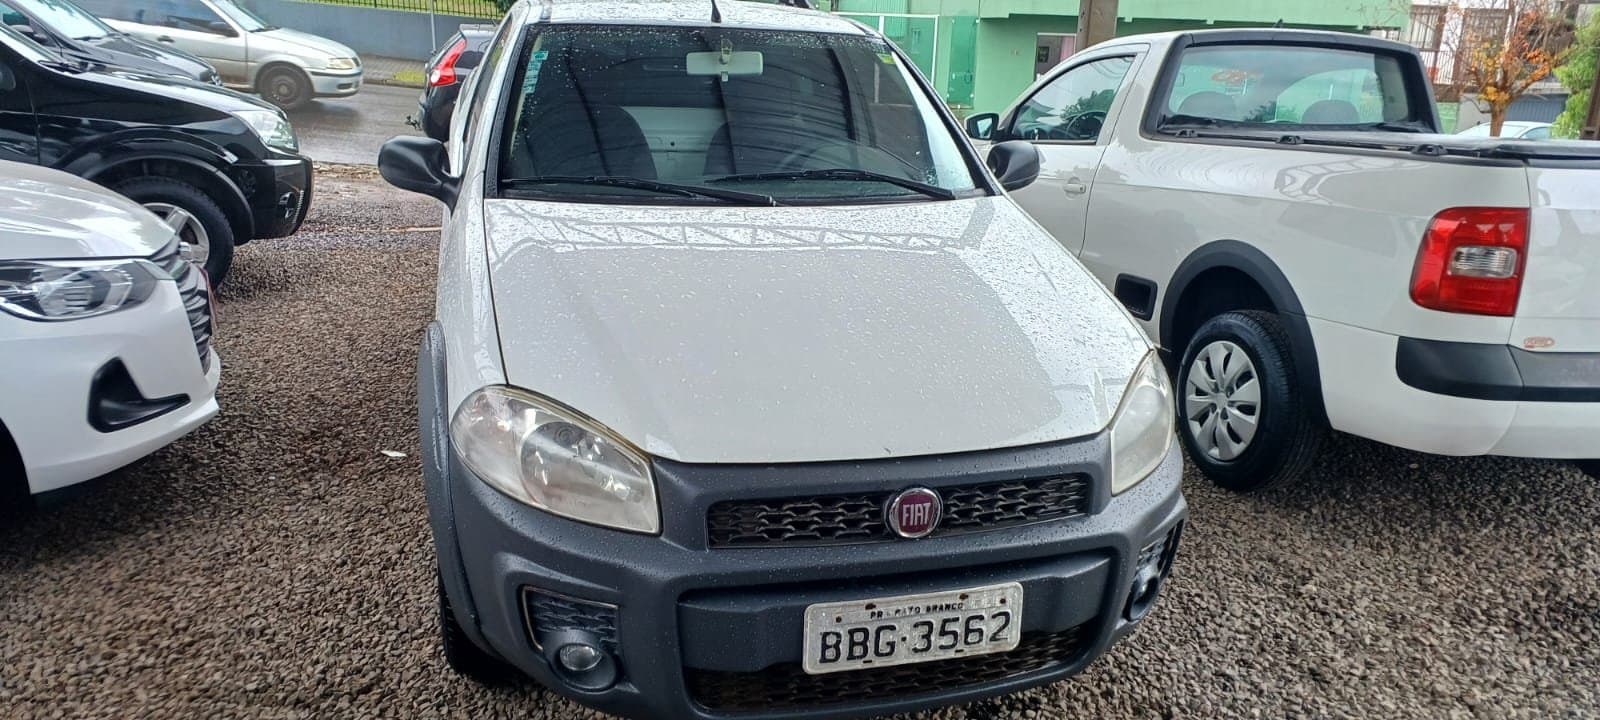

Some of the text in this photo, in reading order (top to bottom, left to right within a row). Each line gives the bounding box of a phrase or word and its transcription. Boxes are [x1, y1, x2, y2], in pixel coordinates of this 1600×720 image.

[902, 502, 931, 527] FIAT
[870, 610, 884, 619] PR
[926, 602, 964, 613] BRANCO
